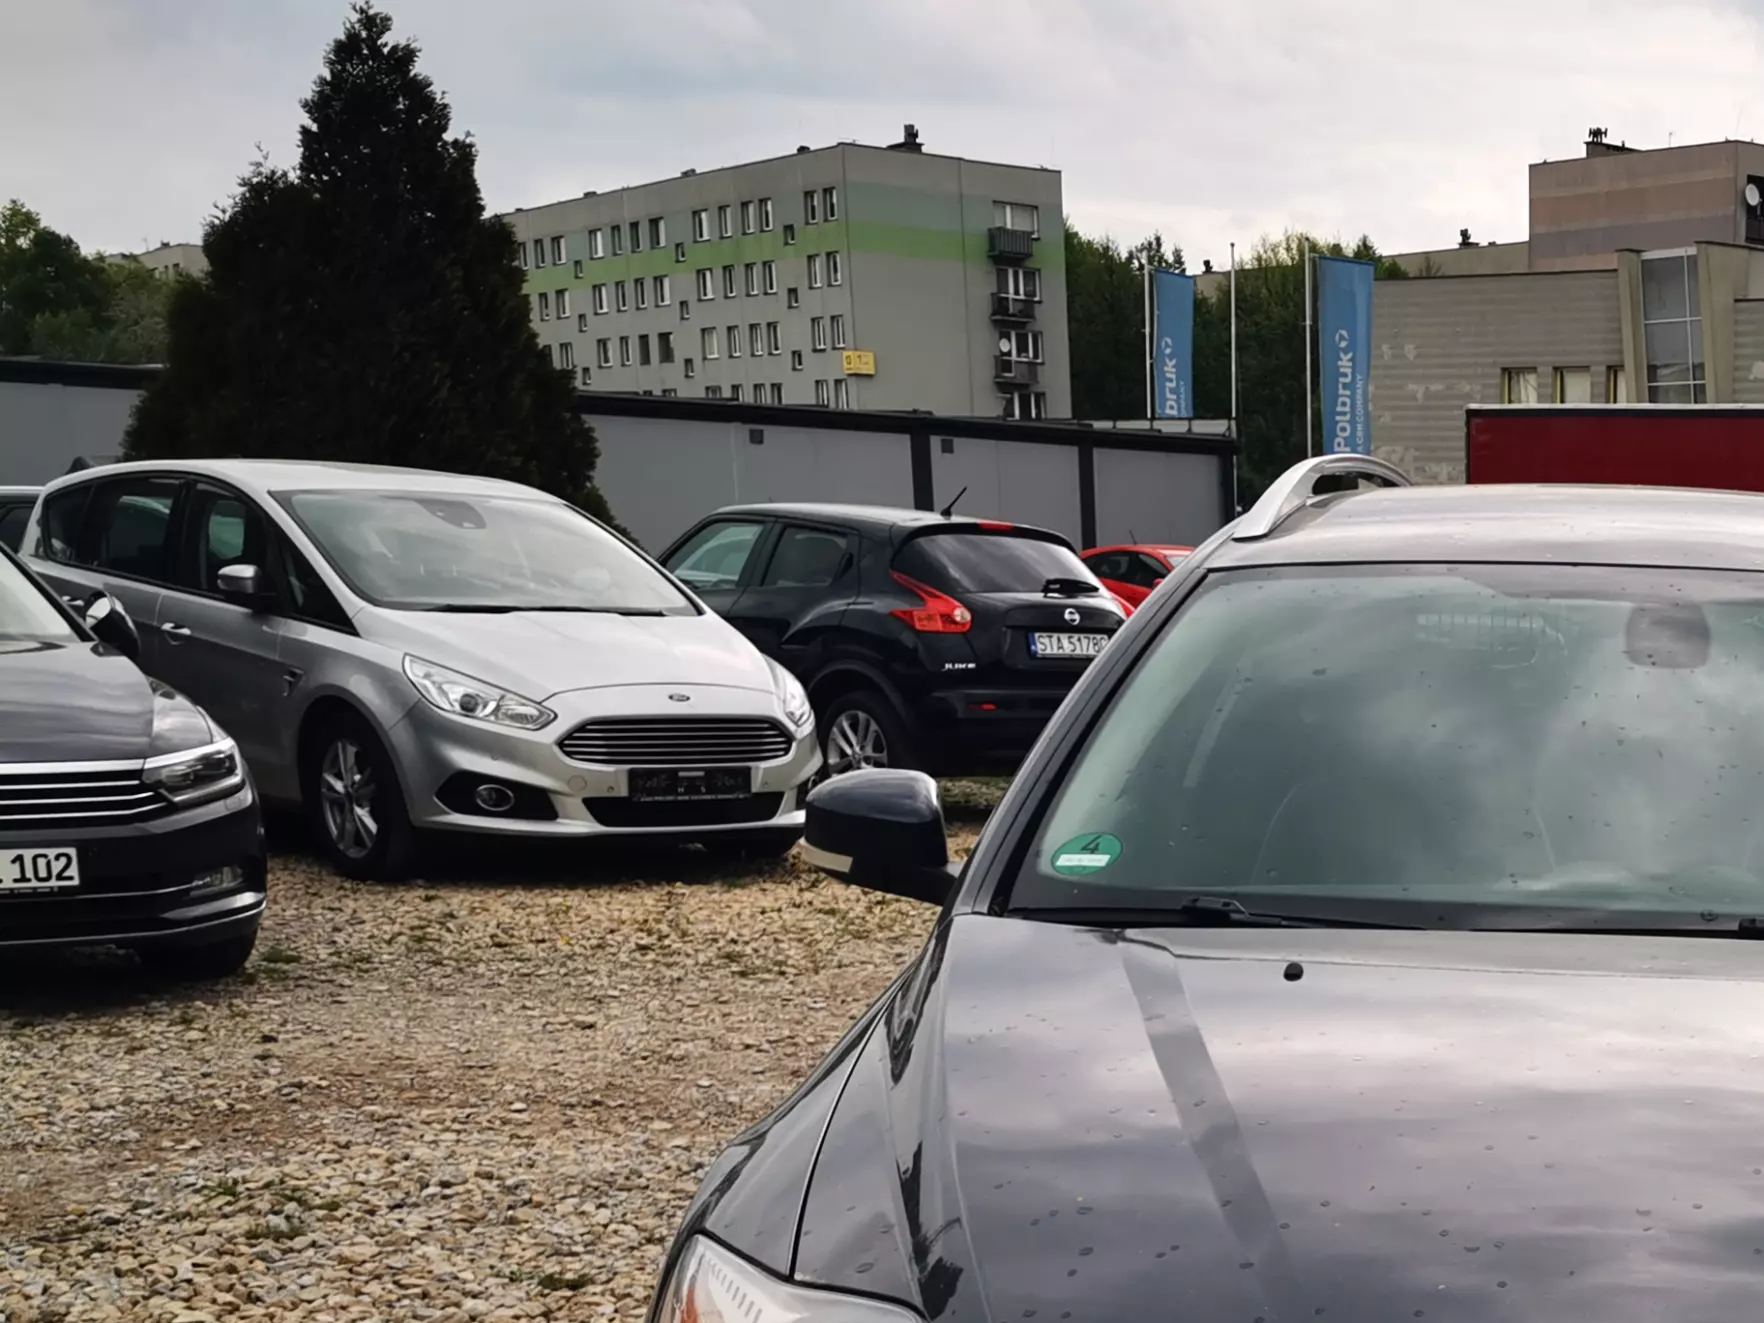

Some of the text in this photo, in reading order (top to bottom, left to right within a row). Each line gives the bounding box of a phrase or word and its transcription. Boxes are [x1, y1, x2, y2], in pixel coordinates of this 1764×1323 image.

[1333, 350, 1354, 453] Polbruk
[1355, 373, 1365, 423] COMPANY
[1037, 635, 1065, 653] STA
[10, 851, 75, 883] 102
